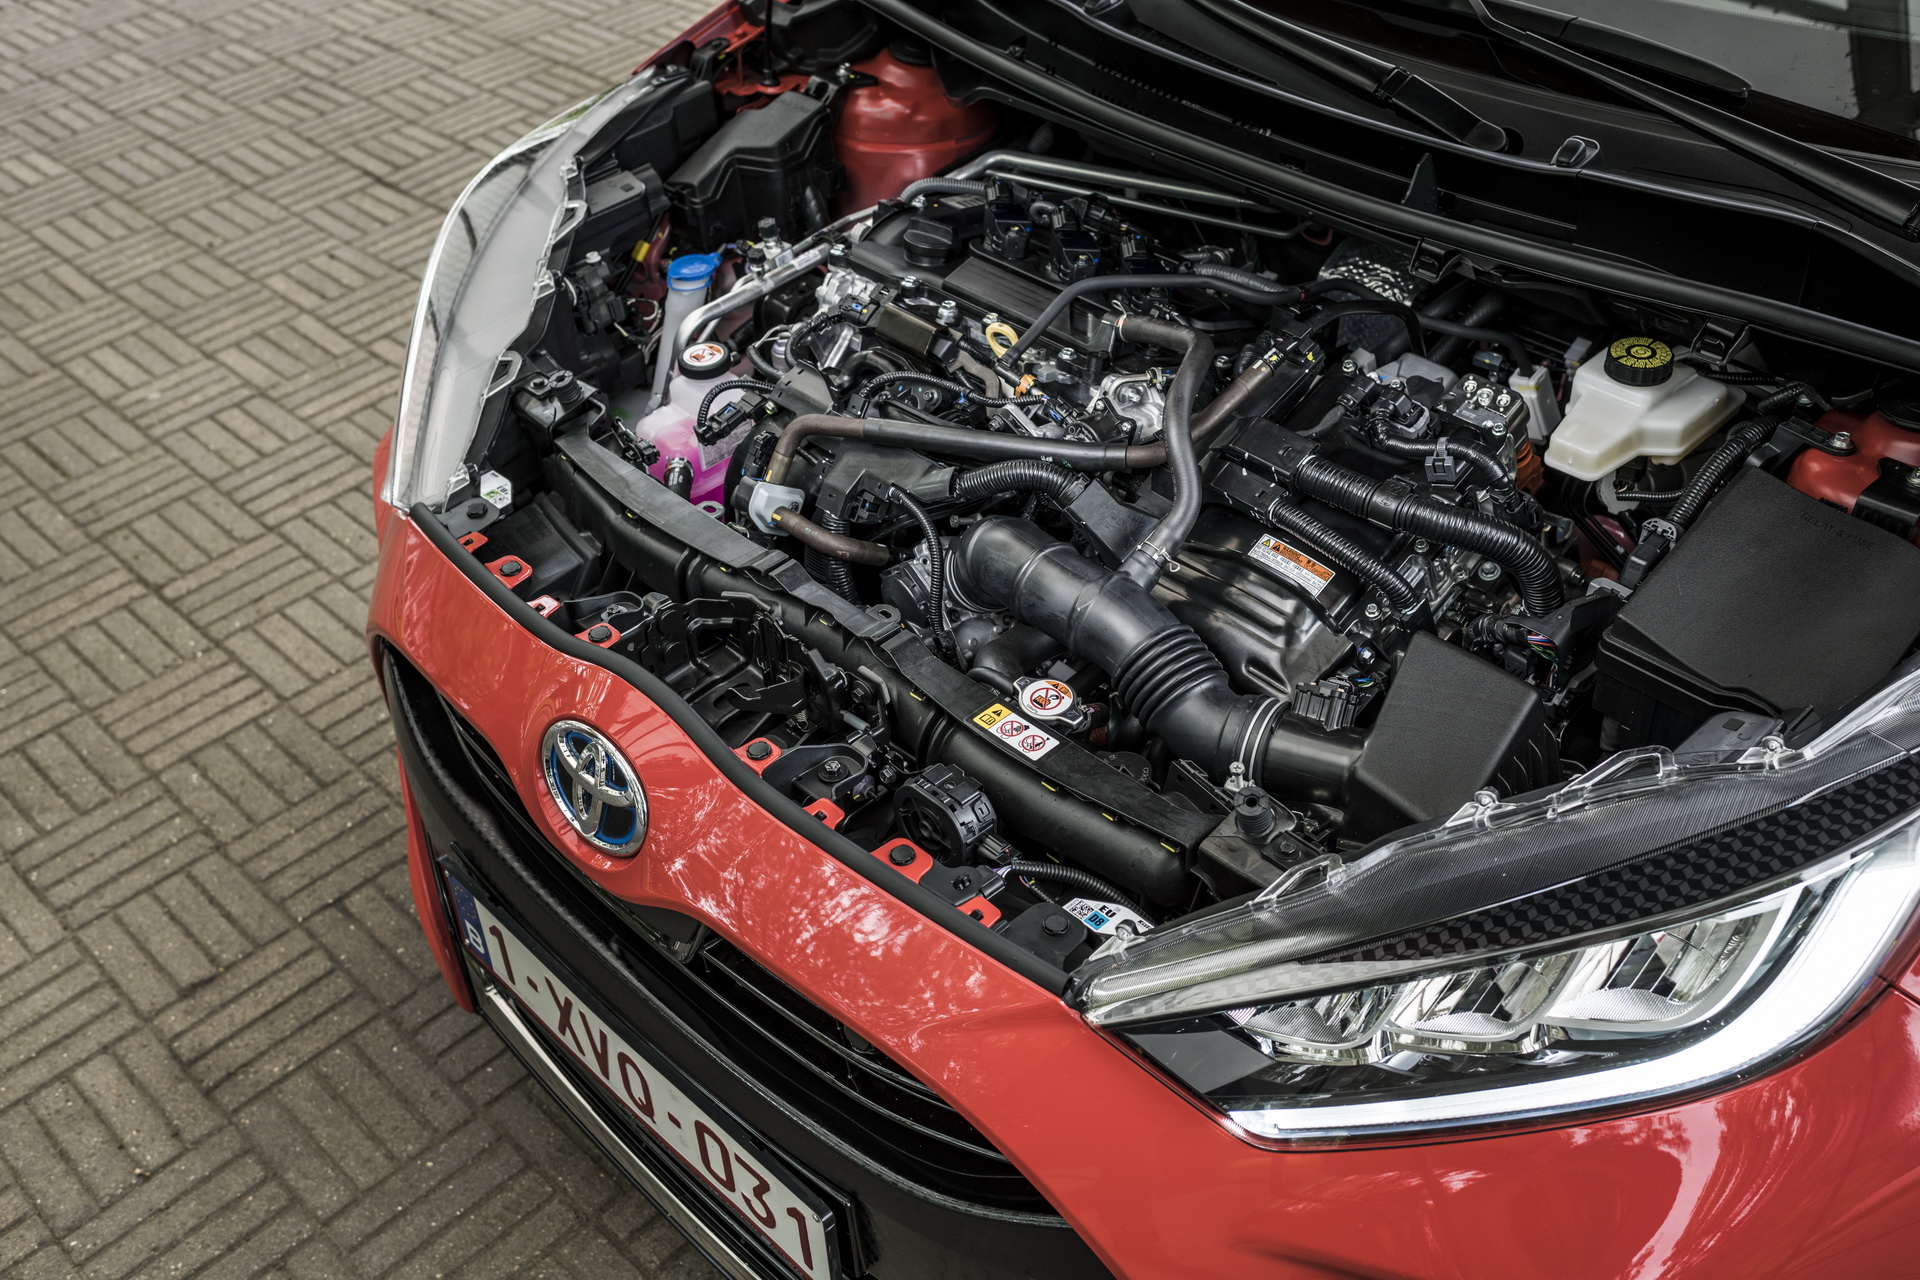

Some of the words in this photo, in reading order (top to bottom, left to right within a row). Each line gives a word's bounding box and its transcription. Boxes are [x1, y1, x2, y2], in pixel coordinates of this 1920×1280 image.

[1801, 512, 1835, 532] RELAY
[1088, 913, 1104, 927] D8
[1099, 905, 1117, 918] EU
[465, 920, 485, 955] B
[489, 925, 813, 1271] 1-XVQ-031
